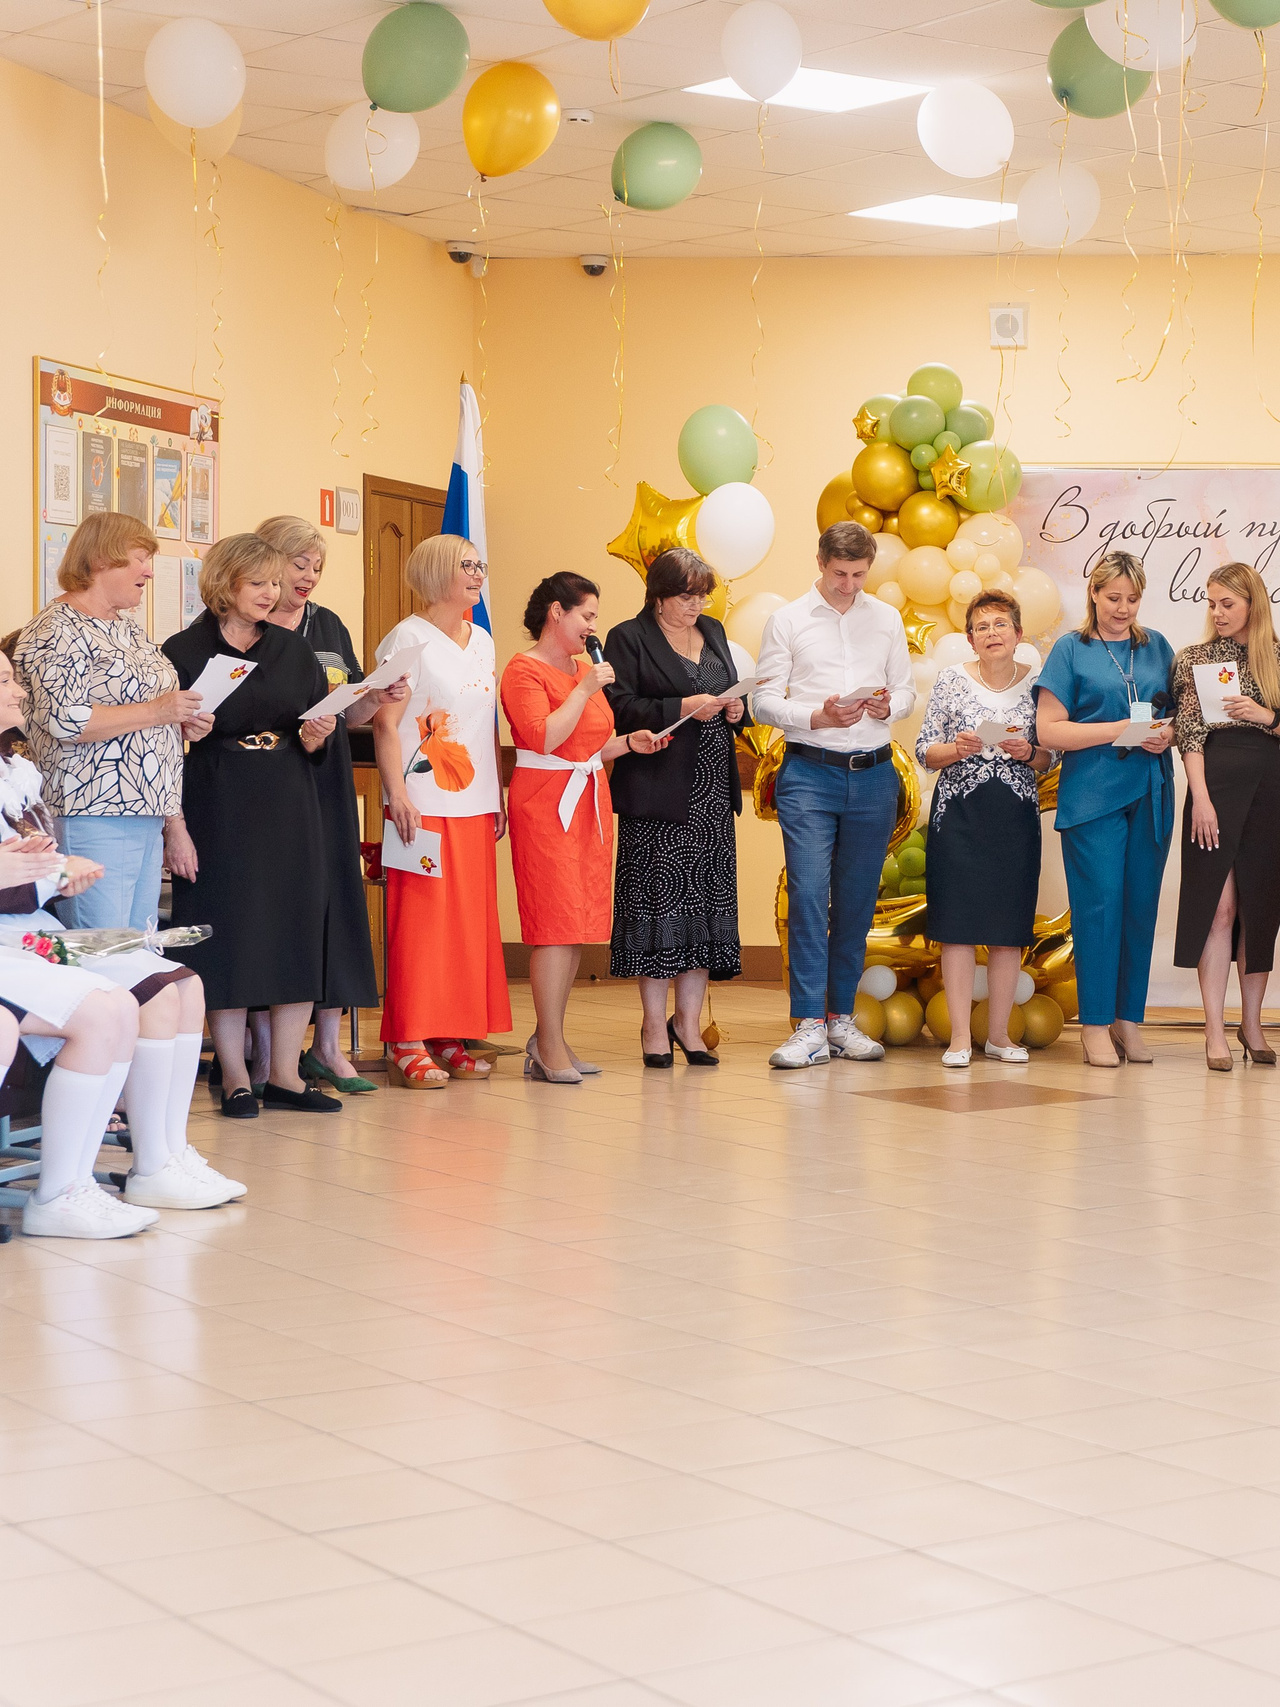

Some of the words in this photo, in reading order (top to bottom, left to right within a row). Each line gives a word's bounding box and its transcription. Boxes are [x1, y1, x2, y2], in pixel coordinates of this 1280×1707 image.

[105, 396, 162, 419] ИНФОРМАЦИЯ
[342, 500, 359, 519] 0011
[1039, 485, 1090, 543] В
[1083, 498, 1230, 579] добрый
